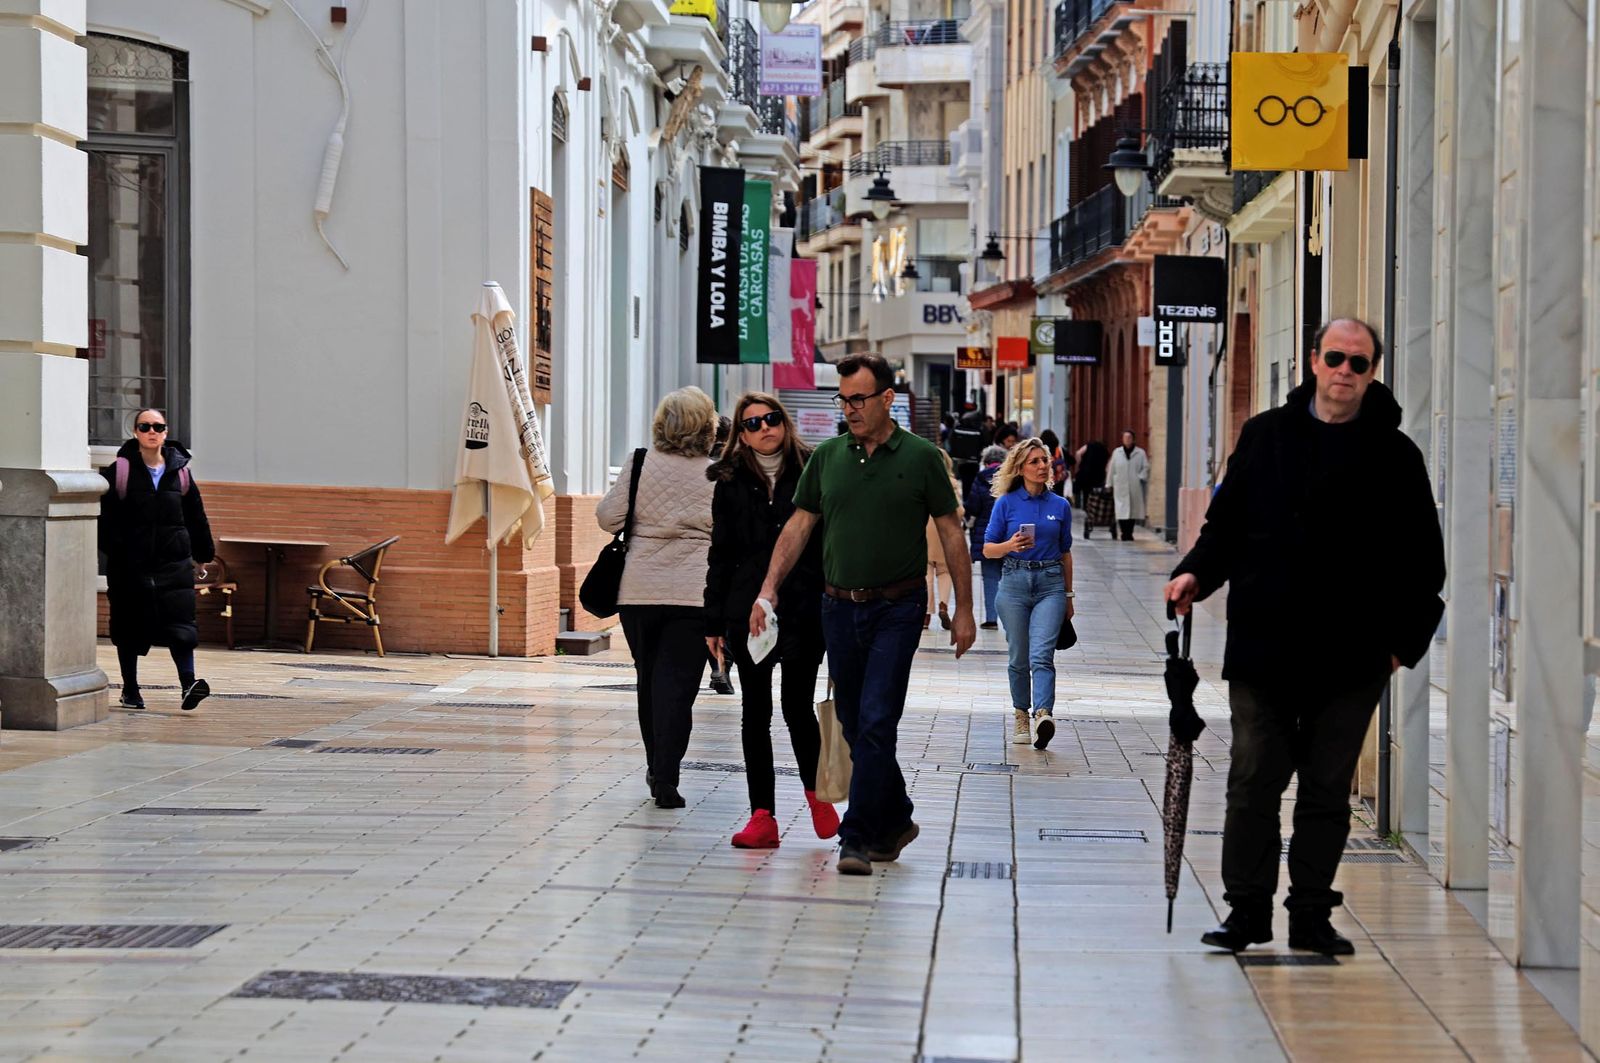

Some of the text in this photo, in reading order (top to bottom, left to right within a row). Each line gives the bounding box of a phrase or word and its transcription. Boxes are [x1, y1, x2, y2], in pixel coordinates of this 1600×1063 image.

[710, 201, 729, 328] BIMBA Y LOLA
[738, 267, 749, 311] CASA
[750, 228, 764, 317] CARCASAS
[738, 316, 748, 340] LA
